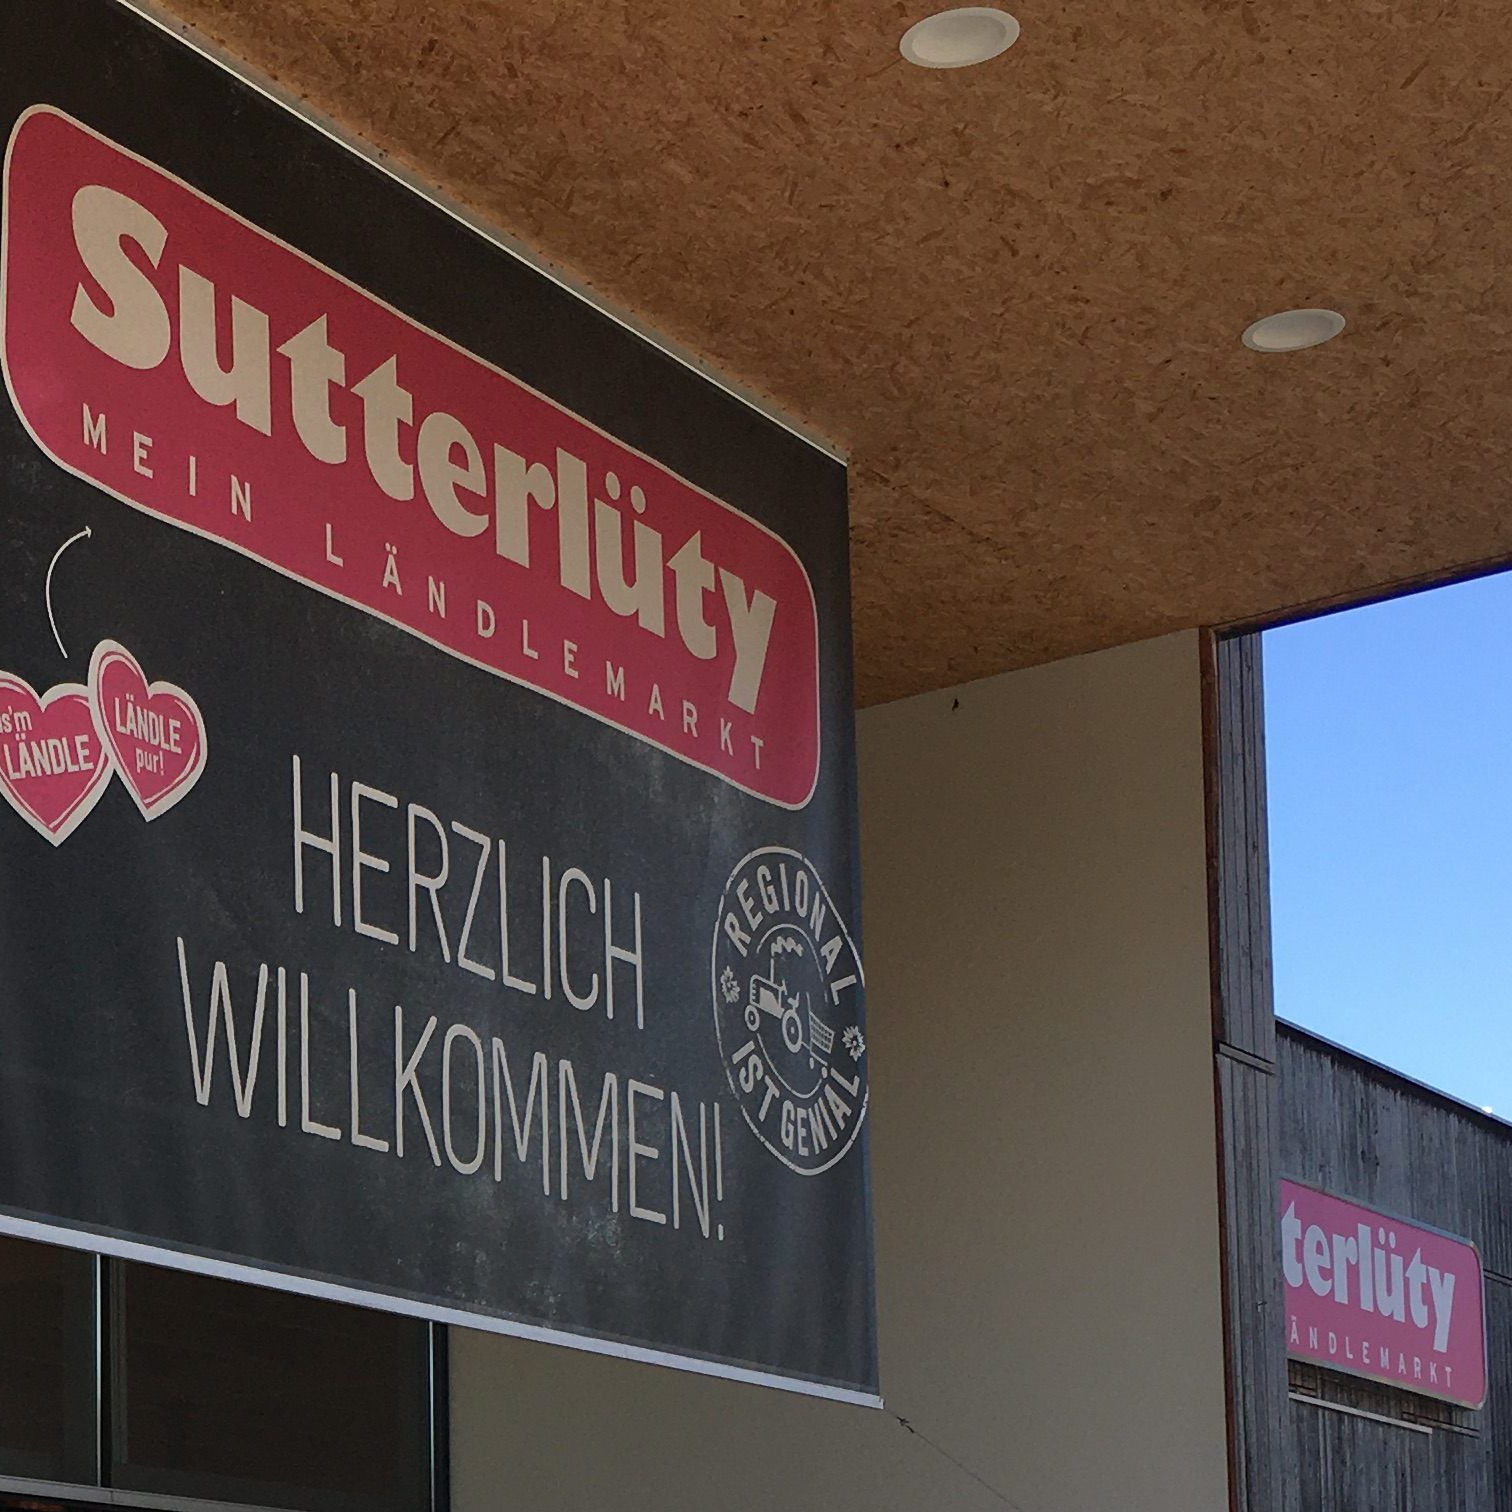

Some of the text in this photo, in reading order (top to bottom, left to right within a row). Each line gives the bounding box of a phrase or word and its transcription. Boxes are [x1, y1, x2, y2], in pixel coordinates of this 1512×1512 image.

[69, 183, 778, 715] Sutterlüty
[82, 402, 767, 771] MEIN LÄNDLEMARKT
[3, 733, 94, 780] LÄNDLE
[114, 693, 182, 754] LÄNDLE
[135, 747, 165, 776] pur!
[292, 754, 644, 1029] HERZLICH
[724, 862, 857, 1006] REGIONAL
[176, 936, 725, 1241] WILLKOMMEN!
[732, 1040, 860, 1157] IST GENIAL
